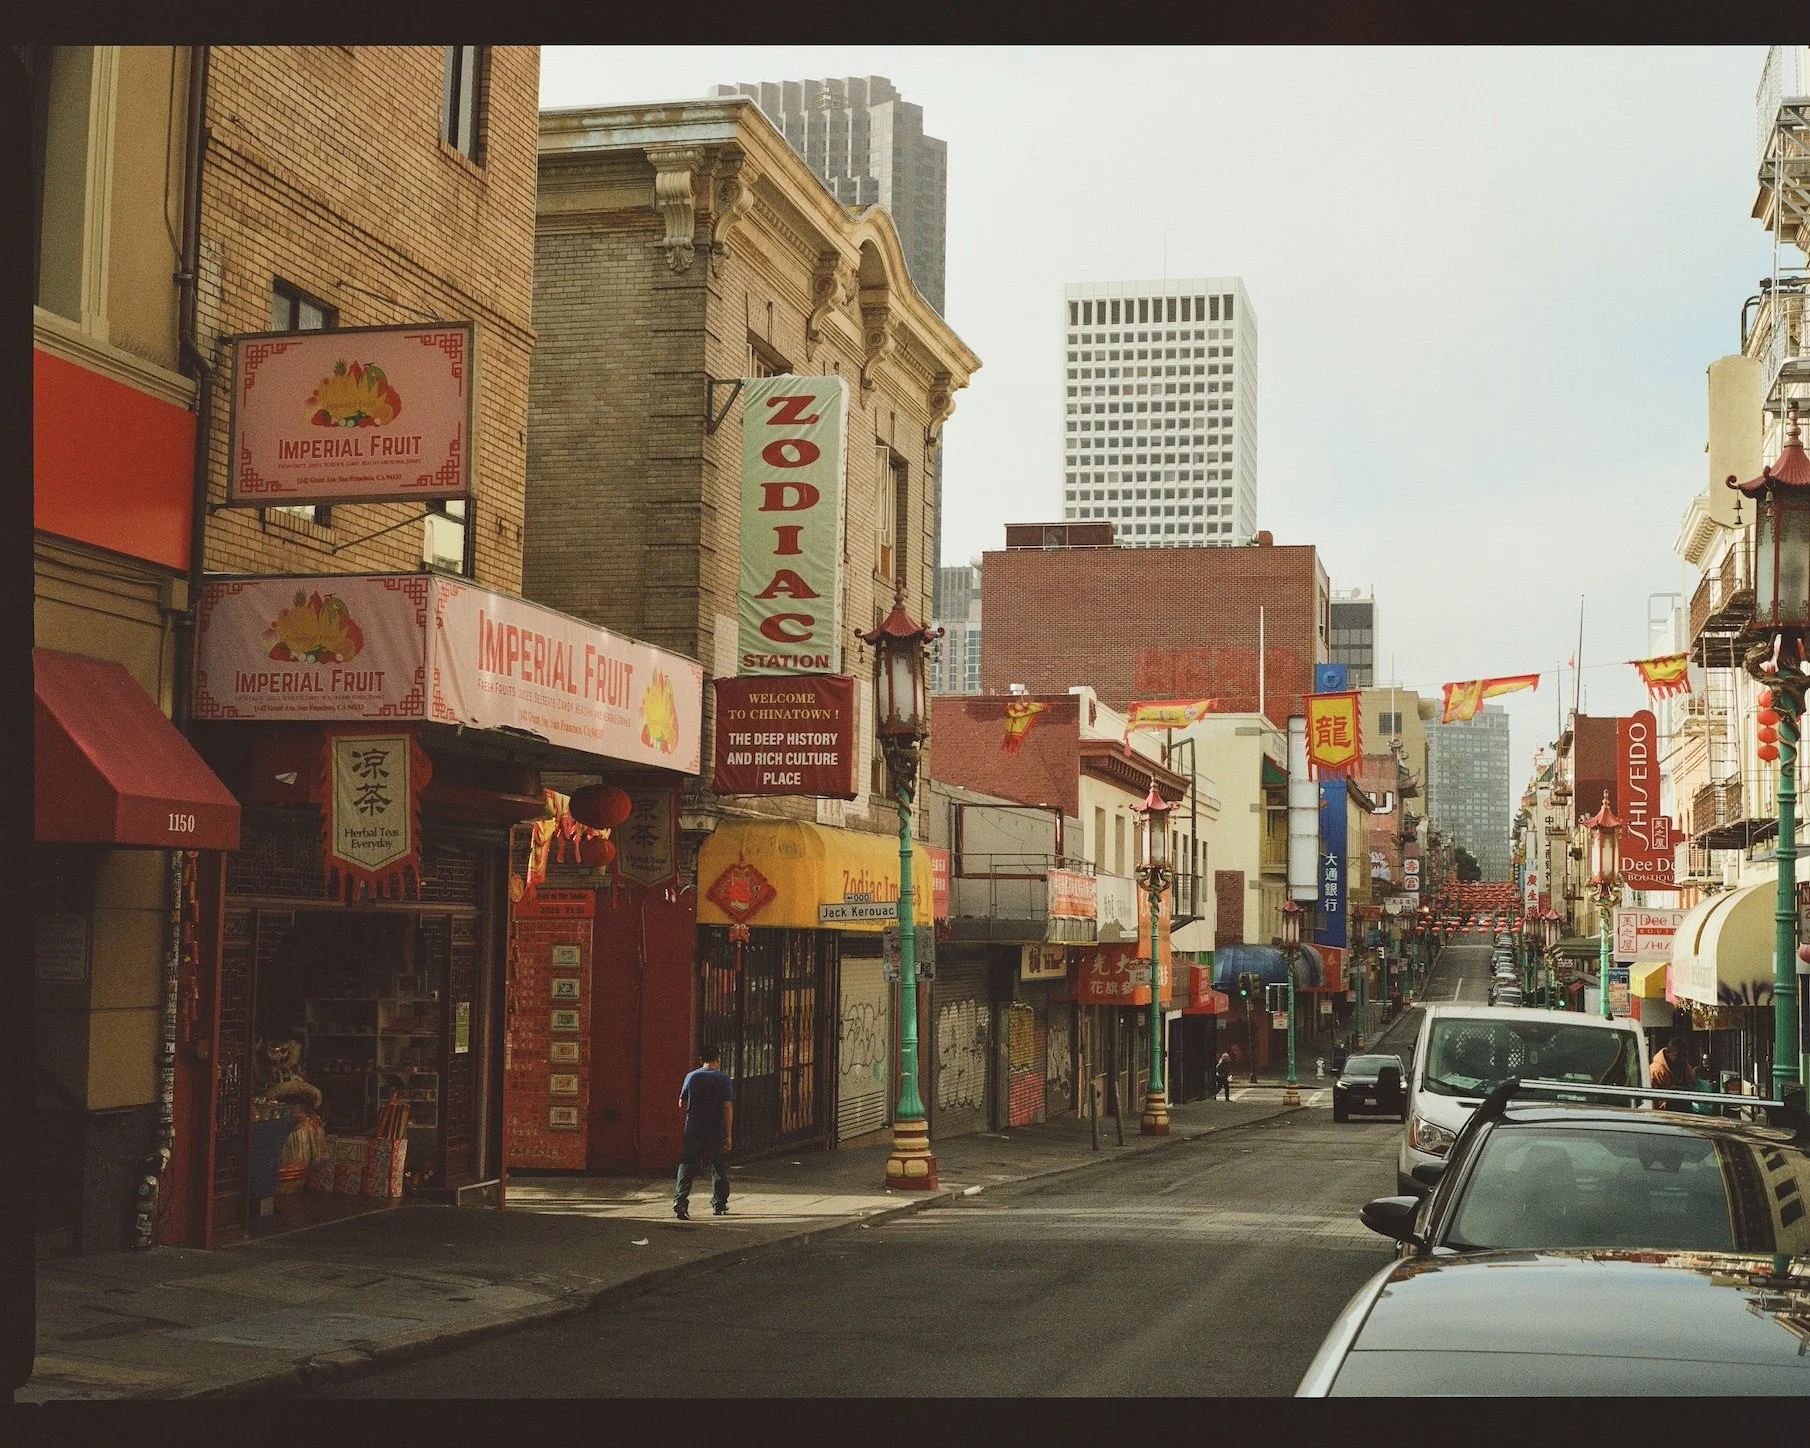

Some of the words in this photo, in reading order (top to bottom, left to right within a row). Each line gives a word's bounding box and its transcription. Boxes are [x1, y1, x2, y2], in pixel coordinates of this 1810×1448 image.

[278, 438, 363, 460] IMPERIAL
[370, 435, 422, 457] FRUIT
[753, 395, 821, 643] ZODIAC
[478, 609, 577, 695] IMPERIAL
[584, 643, 633, 710] FRUIT
[742, 654, 829, 669] STATION
[235, 670, 324, 693] IMPERIAL
[331, 669, 385, 692] FRUIT
[749, 693, 815, 704] WELCOME
[728, 709, 746, 719] TO
[749, 709, 831, 720] CHINATOWN
[728, 732, 752, 746] THE
[754, 732, 785, 746] DEEP
[786, 732, 839, 746] HISTORY
[1315, 715, 1351, 749] 龍
[727, 752, 752, 765] AND
[755, 752, 783, 765] RICH
[785, 752, 839, 765] CULTURE
[763, 772, 801, 785] PLACE
[1628, 722, 1650, 852] SHISEIDO
[168, 813, 195, 833] 1150
[345, 827, 377, 838] Herbal
[379, 827, 399, 838] Teas
[351, 839, 393, 851] Everyday
[1621, 858, 1653, 871] Dee
[843, 870, 882, 903] Zodiac
[1324, 852, 1338, 912] 大通銀行
[823, 907, 847, 918] Jack
[852, 906, 894, 917] Kerouac
[1640, 914, 1667, 926] Dee
